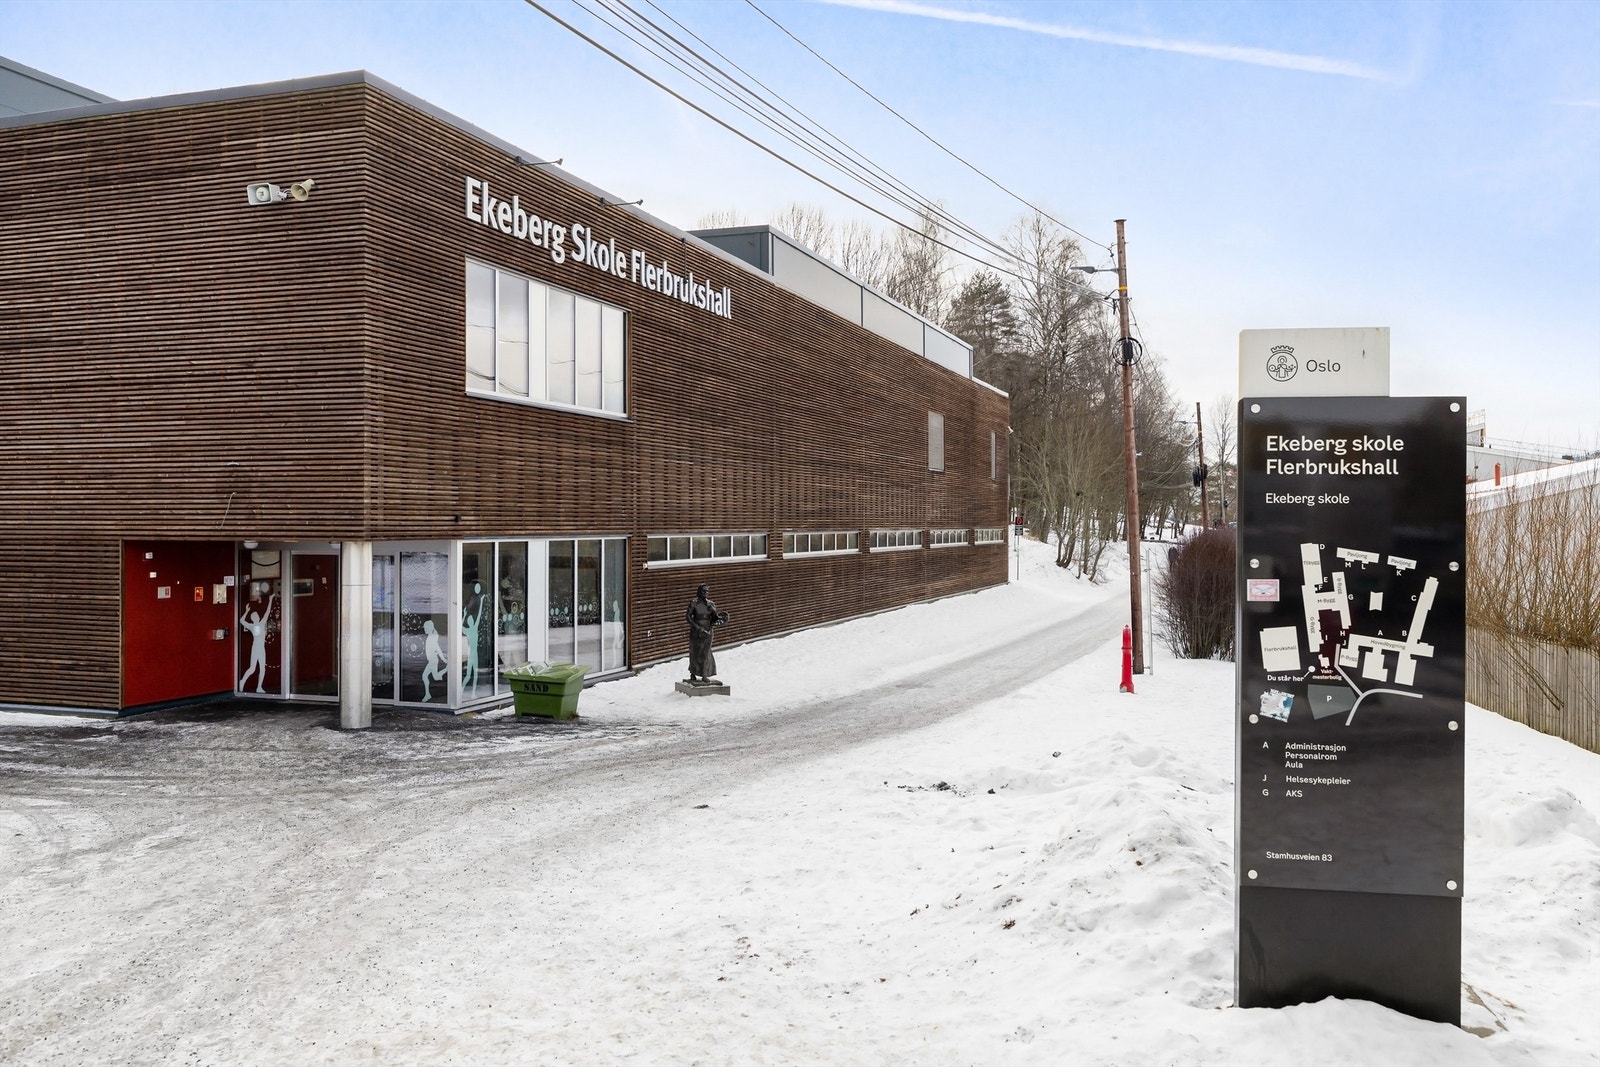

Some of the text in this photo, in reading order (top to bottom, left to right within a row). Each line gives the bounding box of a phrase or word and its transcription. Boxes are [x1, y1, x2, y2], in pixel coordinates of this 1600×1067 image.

[465, 176, 732, 320] Ekeberg Skole Flerbrukshall
[1306, 359, 1341, 373] Oslo
[1266, 435, 1405, 456] Ekeberg skole
[1266, 459, 1399, 475] Flerbrukshall
[1265, 493, 1350, 507] Ekeberg skole
[1396, 569, 1402, 577] K
[1410, 594, 1417, 602] C
[1277, 674, 1292, 682] står
[524, 683, 549, 692] SAND
[1262, 741, 1346, 752] A Administrasjon
[1285, 752, 1338, 760] Personalrom
[1262, 774, 1351, 785] J Helsesykepleier
[1262, 788, 1303, 797] G AKS
[1266, 851, 1333, 862] Stamhusveien 83
